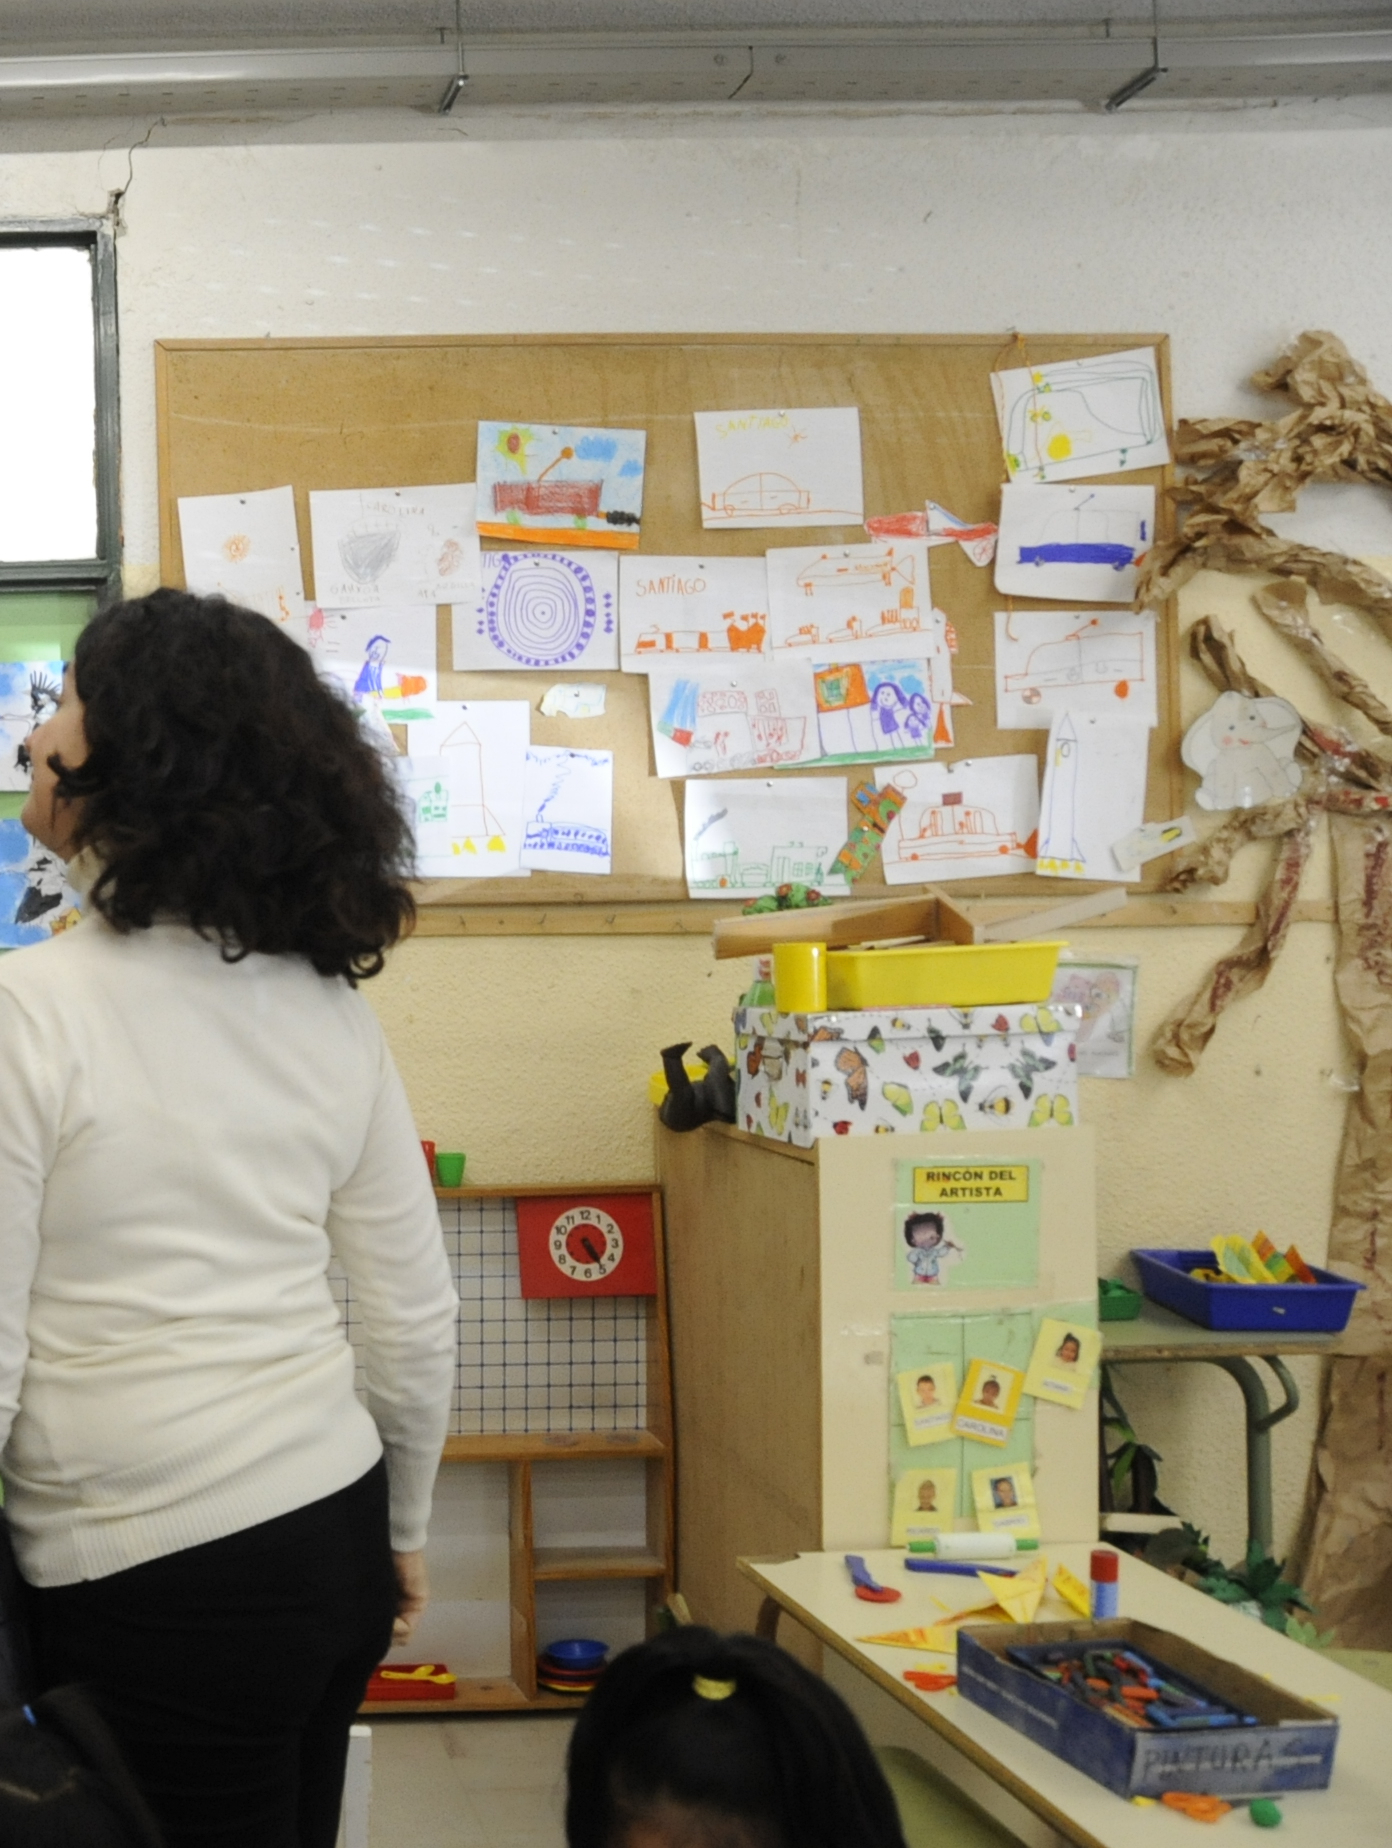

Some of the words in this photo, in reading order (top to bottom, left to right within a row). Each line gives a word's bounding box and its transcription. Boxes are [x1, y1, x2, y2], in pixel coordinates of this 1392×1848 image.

[926, 1168, 983, 1182] RINCÓN
[989, 1170, 1016, 1180] DEL
[939, 1186, 1003, 1198] ARTISTA
[565, 1214, 575, 1225] 11
[579, 1209, 591, 1221] 12
[555, 1225, 567, 1235] 10
[607, 1223, 615, 1234] 2
[553, 1239, 562, 1250] 9
[611, 1238, 619, 1249] 3
[558, 1254, 566, 1265] 8
[607, 1253, 615, 1263] 4
[570, 1266, 577, 1276] 7
[584, 1268, 592, 1279] 6
[598, 1265, 607, 1275] 5
[957, 1417, 1005, 1438] CAROLINA
